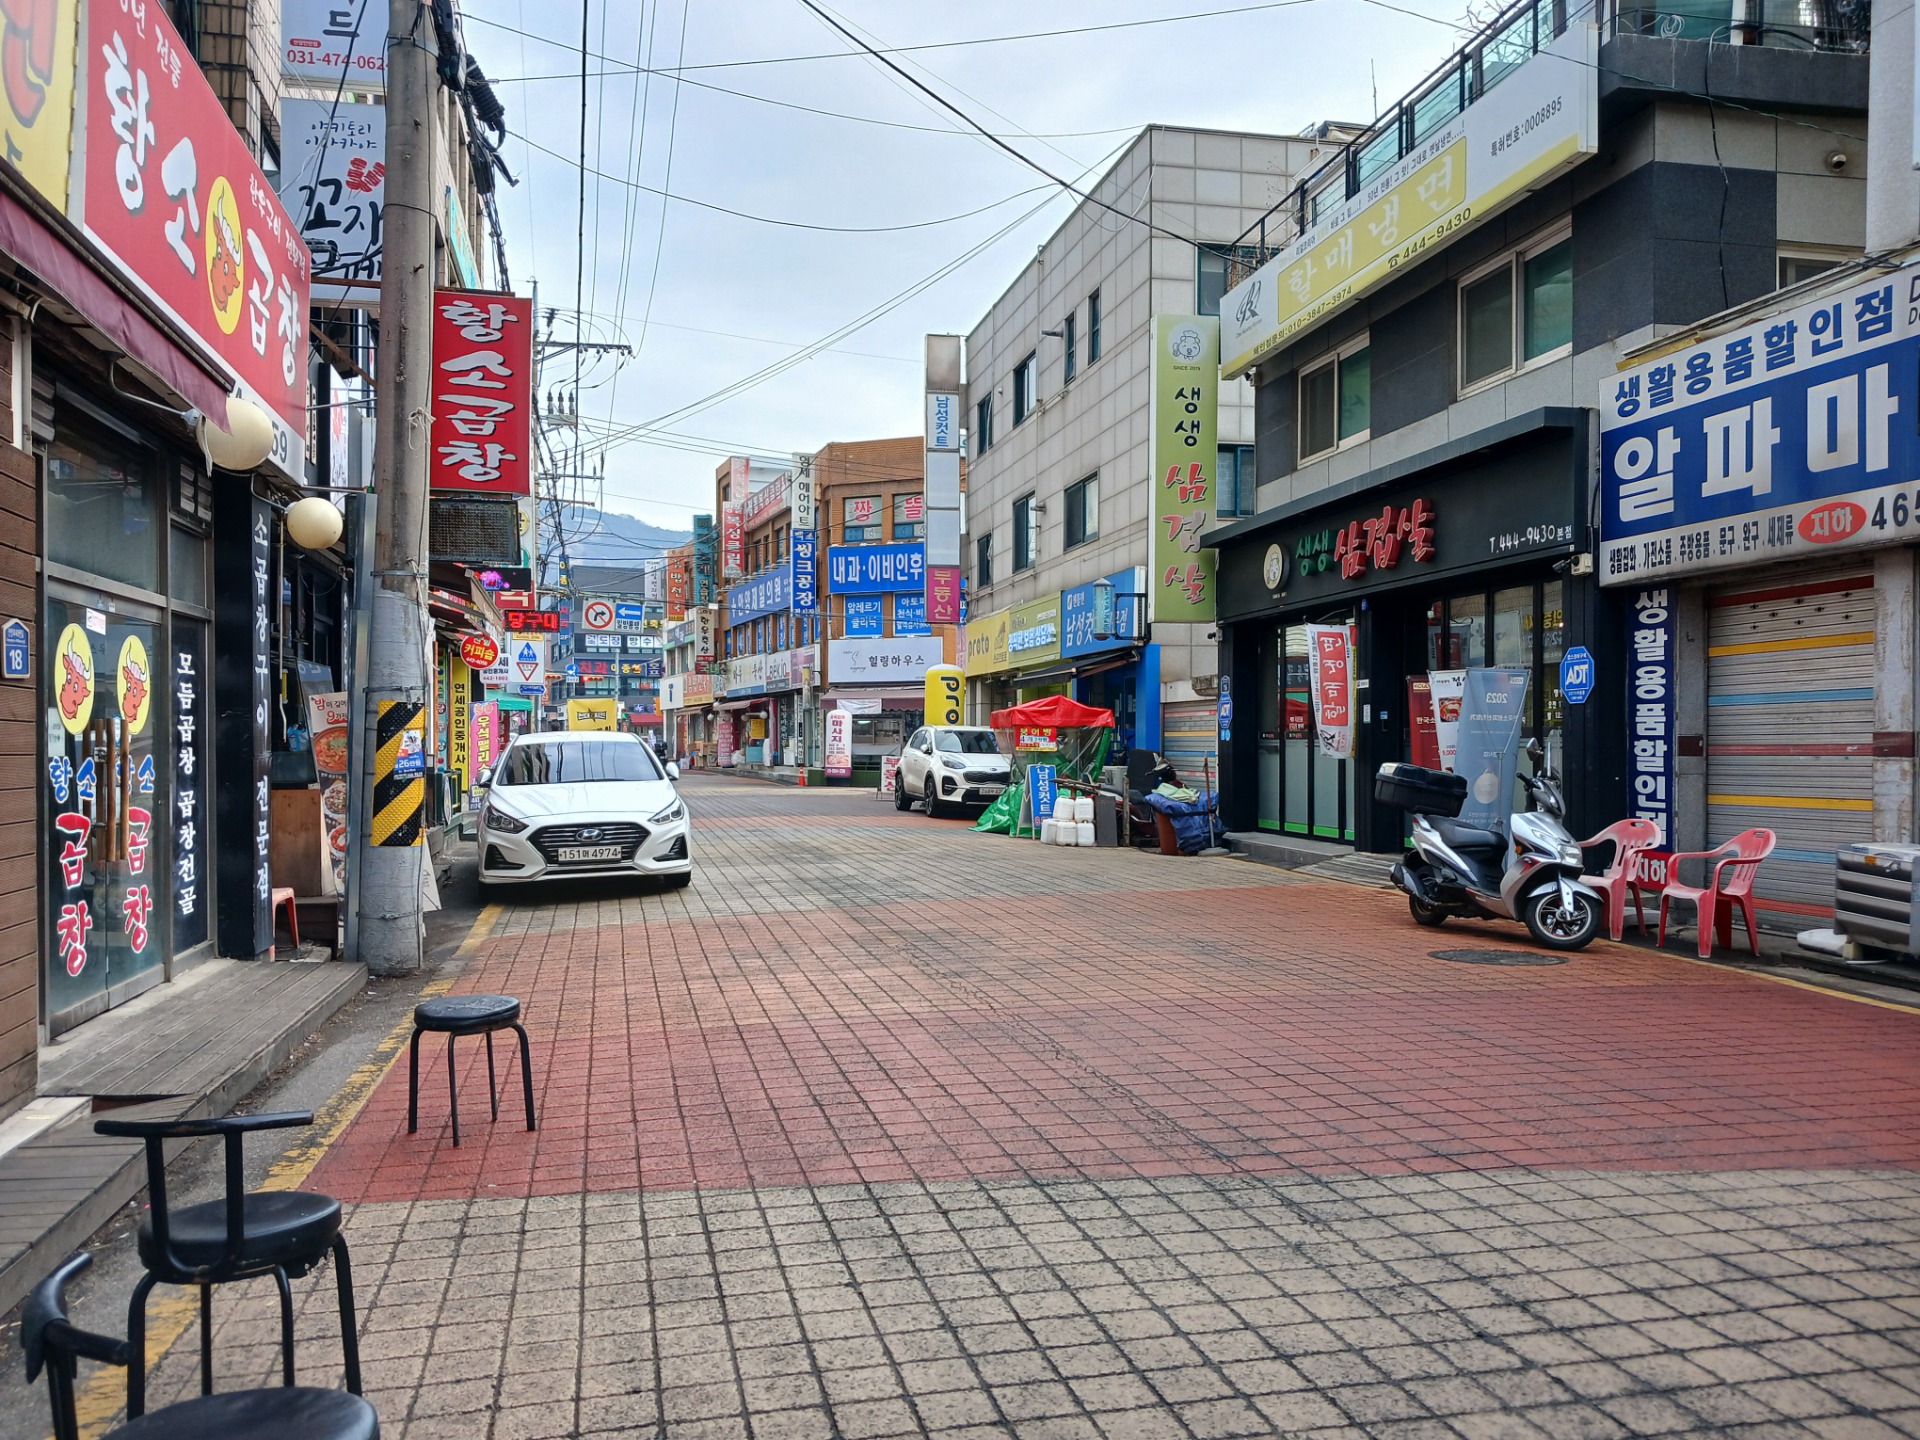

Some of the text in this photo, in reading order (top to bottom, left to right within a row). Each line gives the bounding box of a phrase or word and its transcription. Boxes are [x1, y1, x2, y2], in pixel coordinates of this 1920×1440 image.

[155, 23, 182, 89] 전통
[286, 49, 388, 71] 031-474-062
[1490, 94, 1563, 158] 특허번호:0008895
[1288, 155, 1455, 301] 할매냉면
[246, 227, 301, 387] 곱창
[1614, 284, 1894, 418] 생활용품할인점
[437, 301, 519, 482] 황소곱창
[934, 395, 949, 448] 남성컷트
[1162, 386, 1207, 605] 생생 삼겹살
[1810, 505, 1853, 538] 지하
[1334, 498, 1436, 580] 삼겹살
[1557, 524, 1573, 541] 본점
[1609, 513, 1794, 576] 생활잡화 가전소품 주방용품 문구 완구 세제류
[847, 601, 881, 614] 알레르기
[933, 568, 953, 620] 부동산
[9, 648, 24, 671] 18
[463, 643, 496, 662] 커피숍
[868, 654, 926, 668] 힐링하우스
[968, 633, 990, 662] proto
[1565, 663, 1589, 686] ADT
[1319, 636, 1346, 720] 할매냉면
[454, 683, 466, 765] 연세공인중개사
[830, 719, 844, 743] 마사지
[49, 756, 98, 804] 황소
[176, 653, 198, 916] 모듬곱창 곱창전골
[255, 779, 271, 900] 전문점
[591, 847, 618, 858] 4974
[55, 811, 93, 978] 곱창
